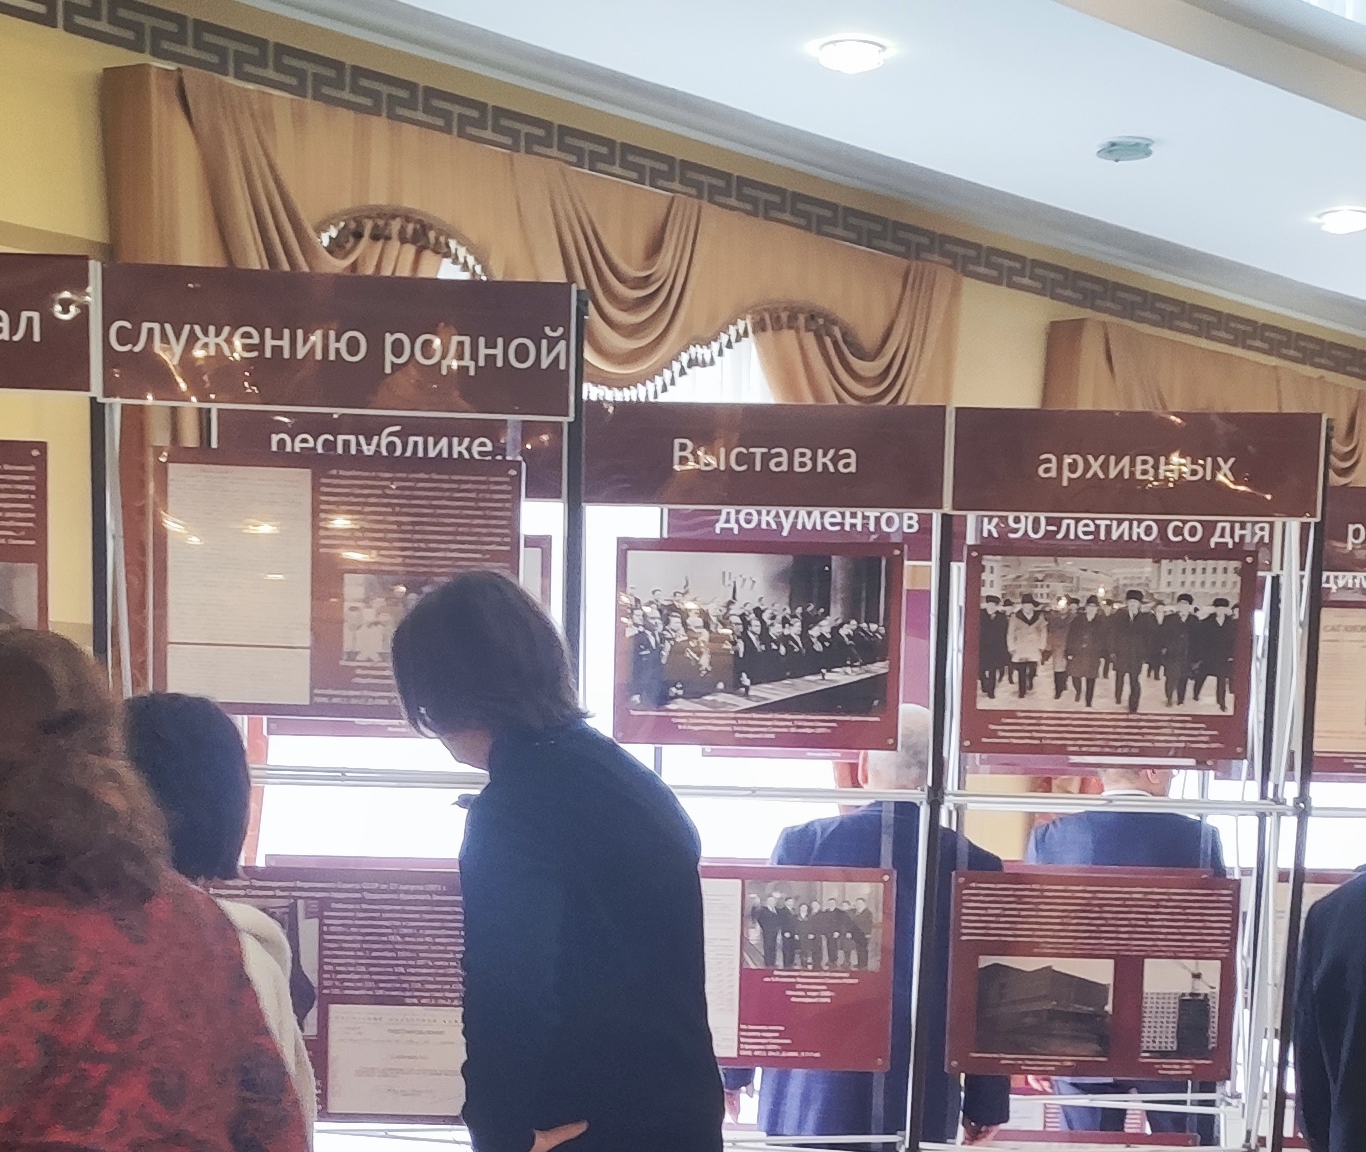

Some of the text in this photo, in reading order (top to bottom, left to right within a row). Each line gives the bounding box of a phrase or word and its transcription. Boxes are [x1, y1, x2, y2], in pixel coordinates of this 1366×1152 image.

[108, 318, 569, 376] служению родной
[672, 437, 858, 474] Выставка
[1037, 451, 1237, 486] архивных
[714, 507, 920, 536] документов
[981, 514, 1271, 549] к 90-летию со дня
